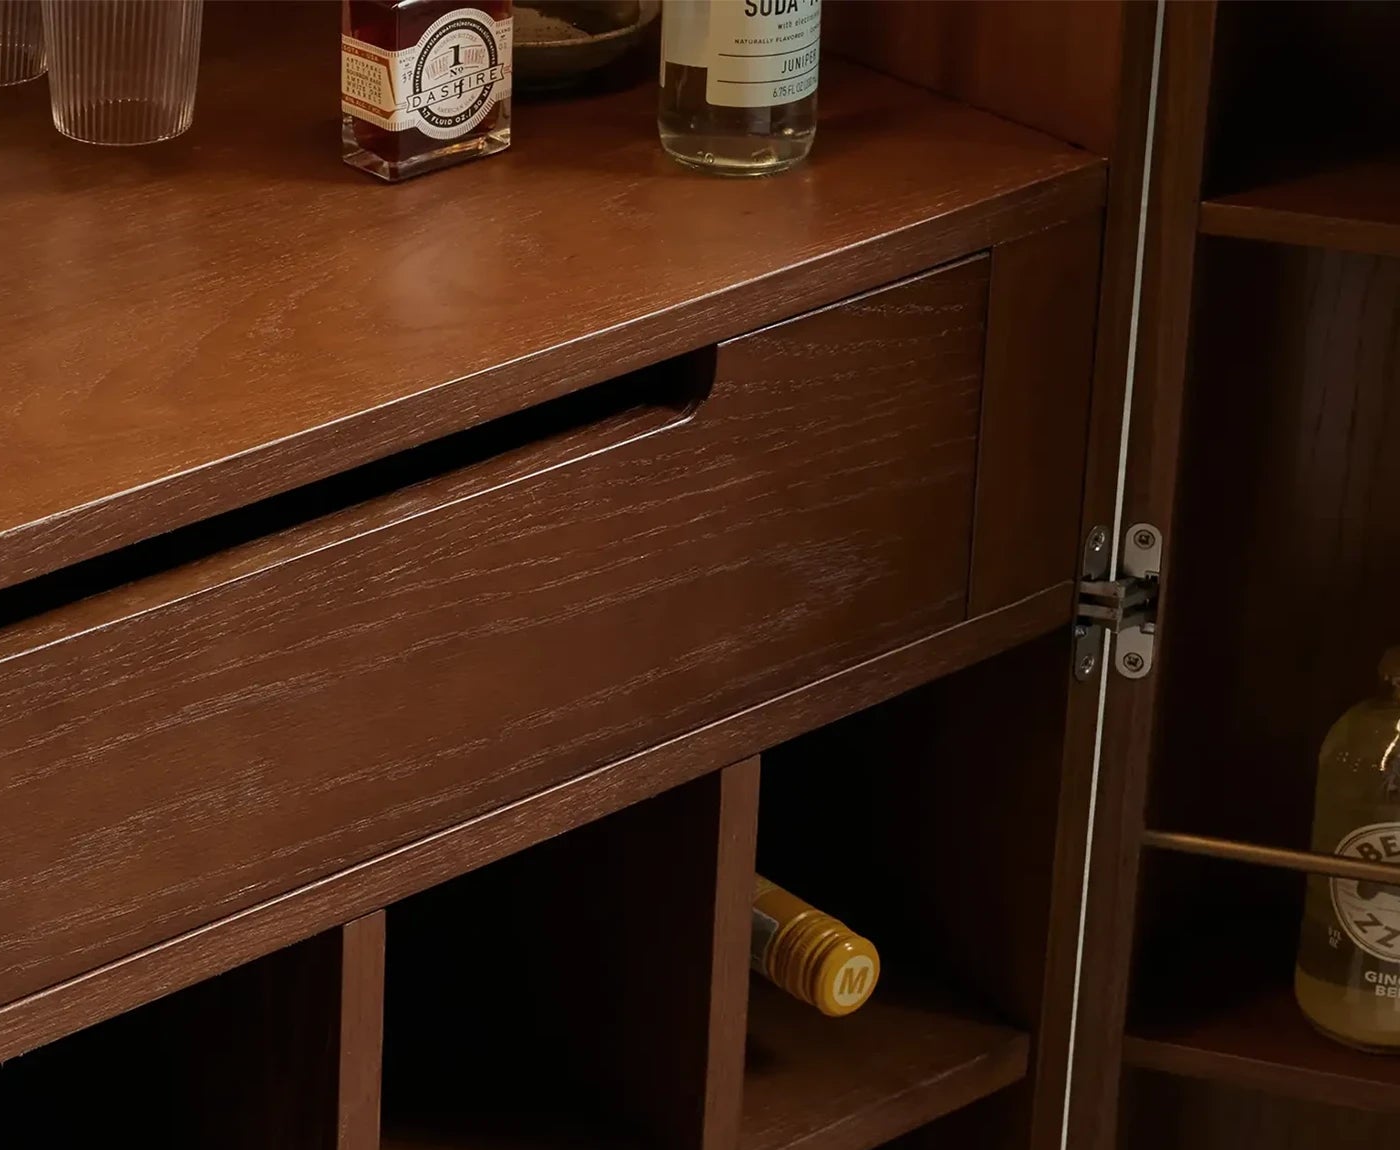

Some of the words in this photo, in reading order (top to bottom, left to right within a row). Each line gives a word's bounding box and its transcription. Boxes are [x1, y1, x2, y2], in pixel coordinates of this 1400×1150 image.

[744, 0, 798, 17] SODA
[775, 31, 805, 43] FLAVORED
[449, 44, 463, 68] 1
[781, 48, 817, 74] JUNIPER
[431, 116, 453, 125] FLUID
[838, 966, 870, 995] M
[1365, 970, 1400, 986] GIN
